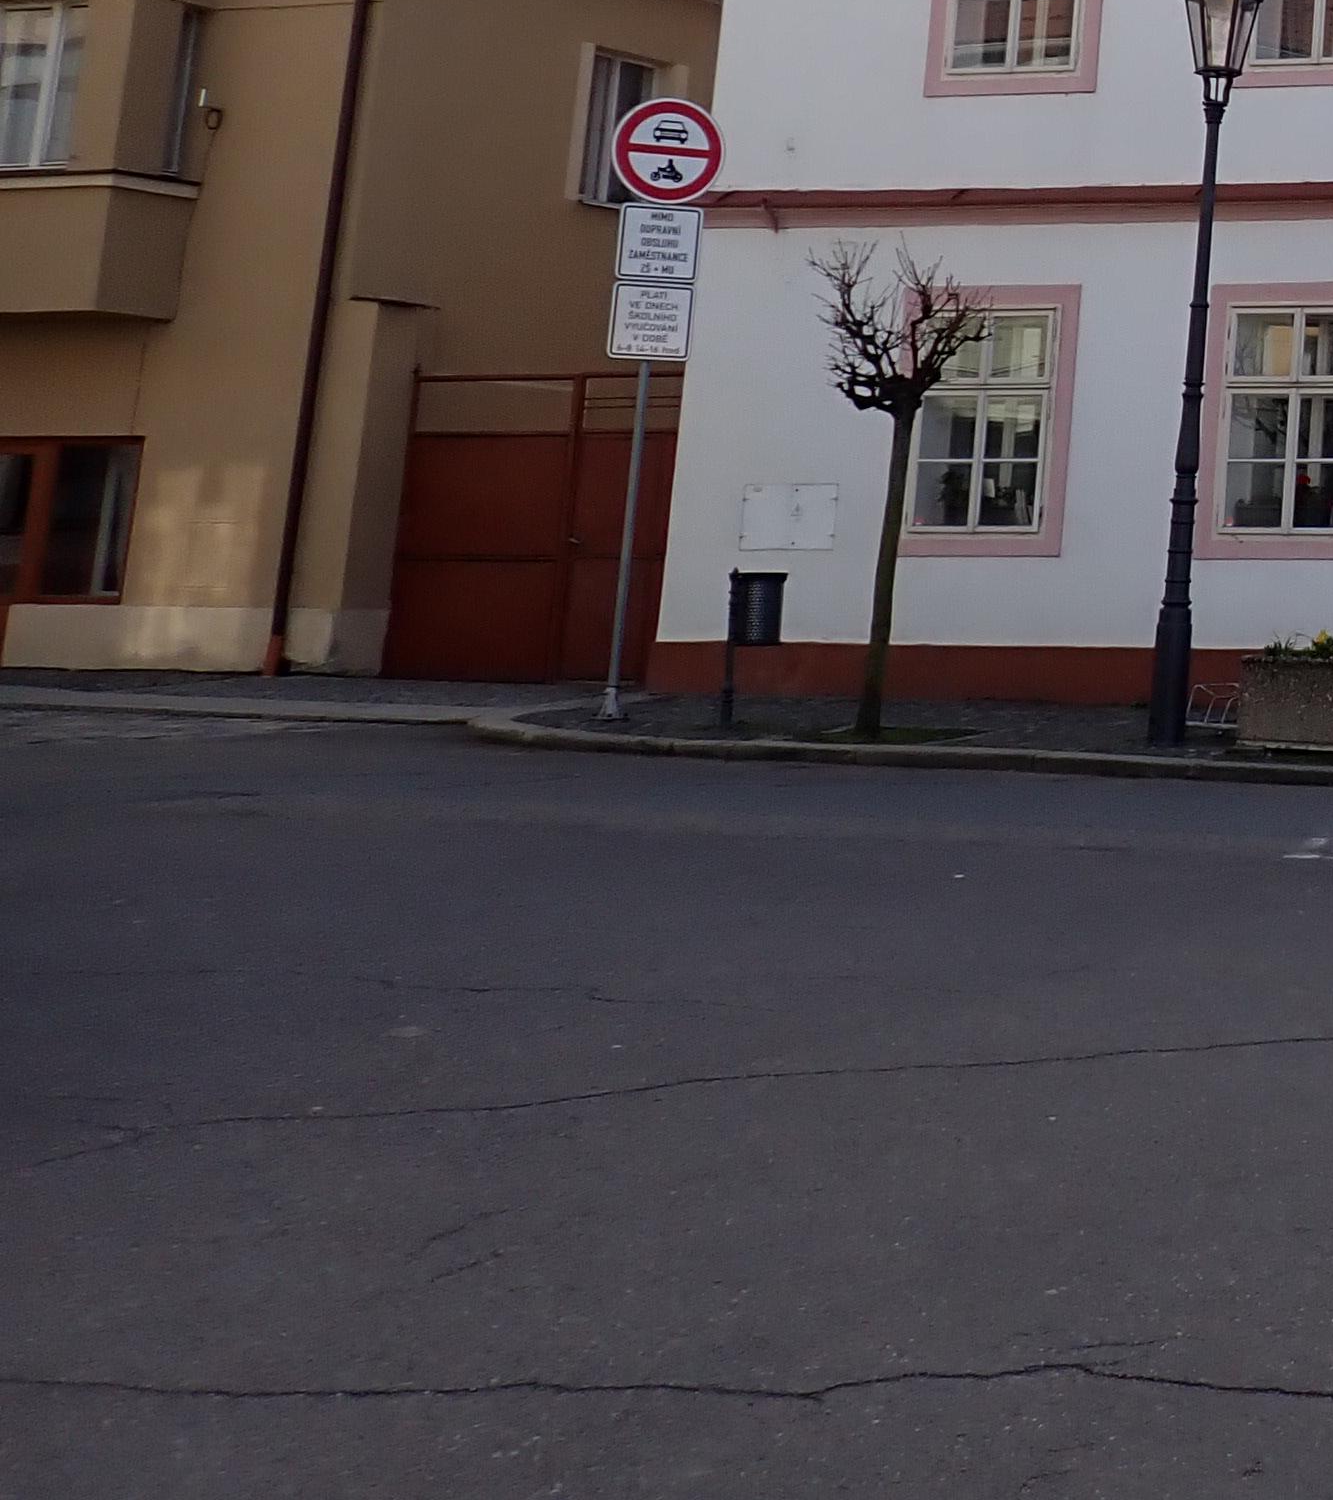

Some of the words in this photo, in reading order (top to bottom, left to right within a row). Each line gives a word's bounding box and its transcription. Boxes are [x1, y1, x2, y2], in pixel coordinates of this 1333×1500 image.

[651, 212, 673, 221] MIMO
[628, 250, 688, 262] ZAMĚSTNANCE
[629, 301, 641, 309] VE
[645, 302, 678, 310] DNECH
